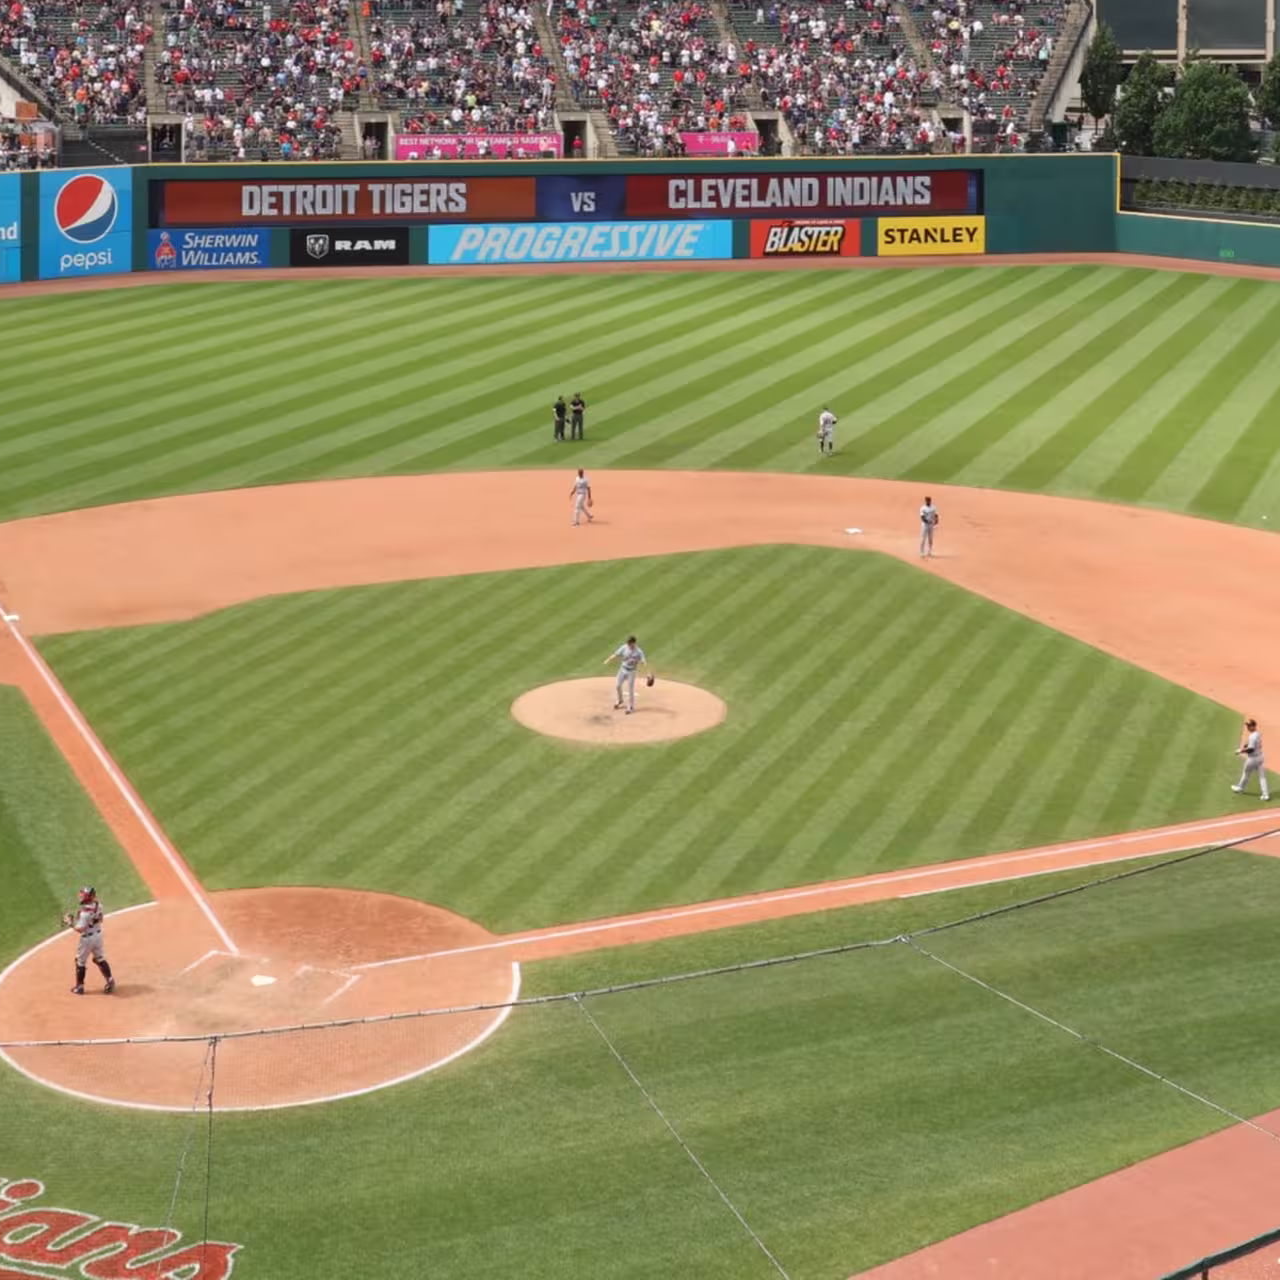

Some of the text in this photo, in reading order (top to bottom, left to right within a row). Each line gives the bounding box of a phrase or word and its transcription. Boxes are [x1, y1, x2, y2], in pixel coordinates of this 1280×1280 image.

[241, 182, 468, 217] DETROIT TIGERS
[570, 191, 596, 213] VS
[667, 175, 932, 210] CLEVELAND INDIANS
[334, 239, 396, 252] RAM
[452, 223, 706, 262] PROGRESSIVE
[764, 225, 844, 254] BLASTER
[884, 226, 979, 244] STANLEY
[59, 251, 113, 272] pepsi
